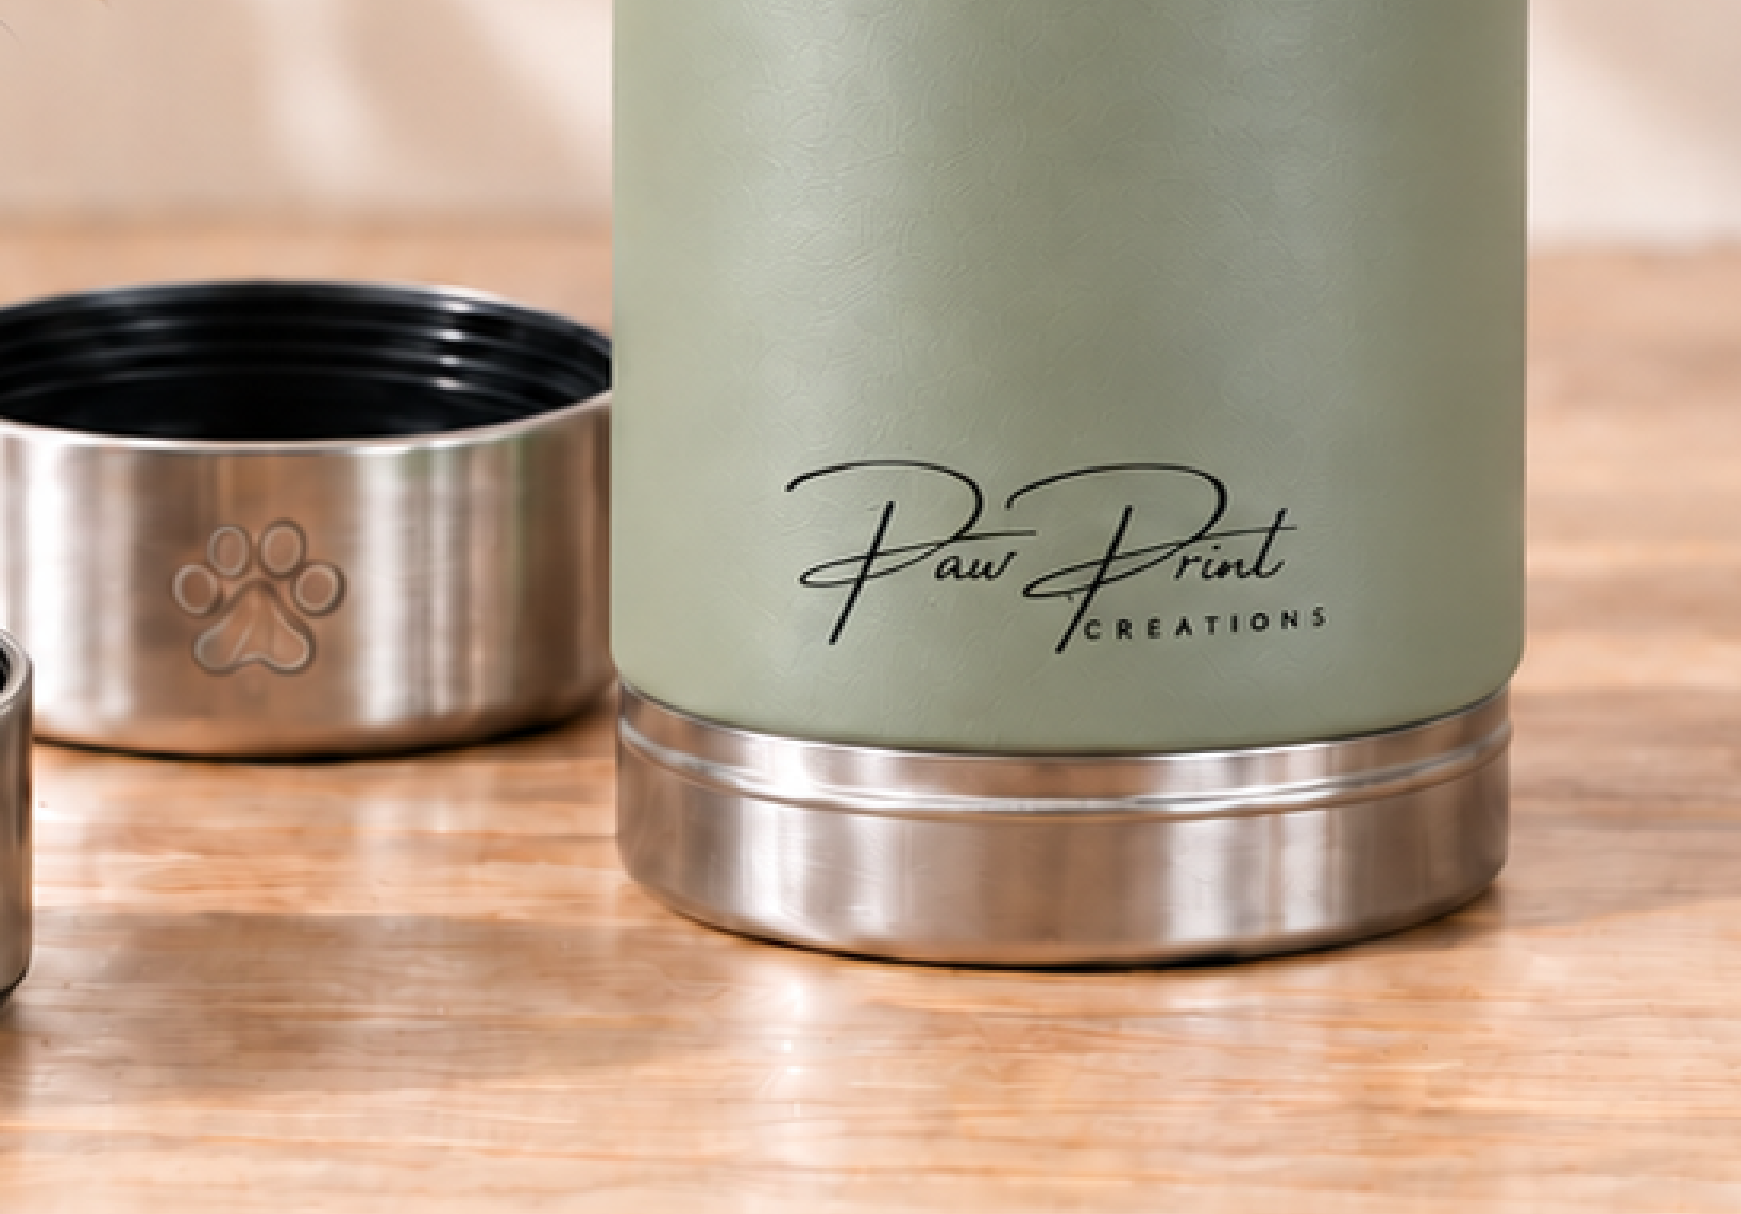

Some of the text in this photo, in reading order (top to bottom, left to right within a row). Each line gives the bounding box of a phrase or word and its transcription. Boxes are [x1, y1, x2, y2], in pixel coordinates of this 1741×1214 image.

[785, 460, 1298, 654] Paw Print
[1083, 606, 1328, 641] CREATIONS
